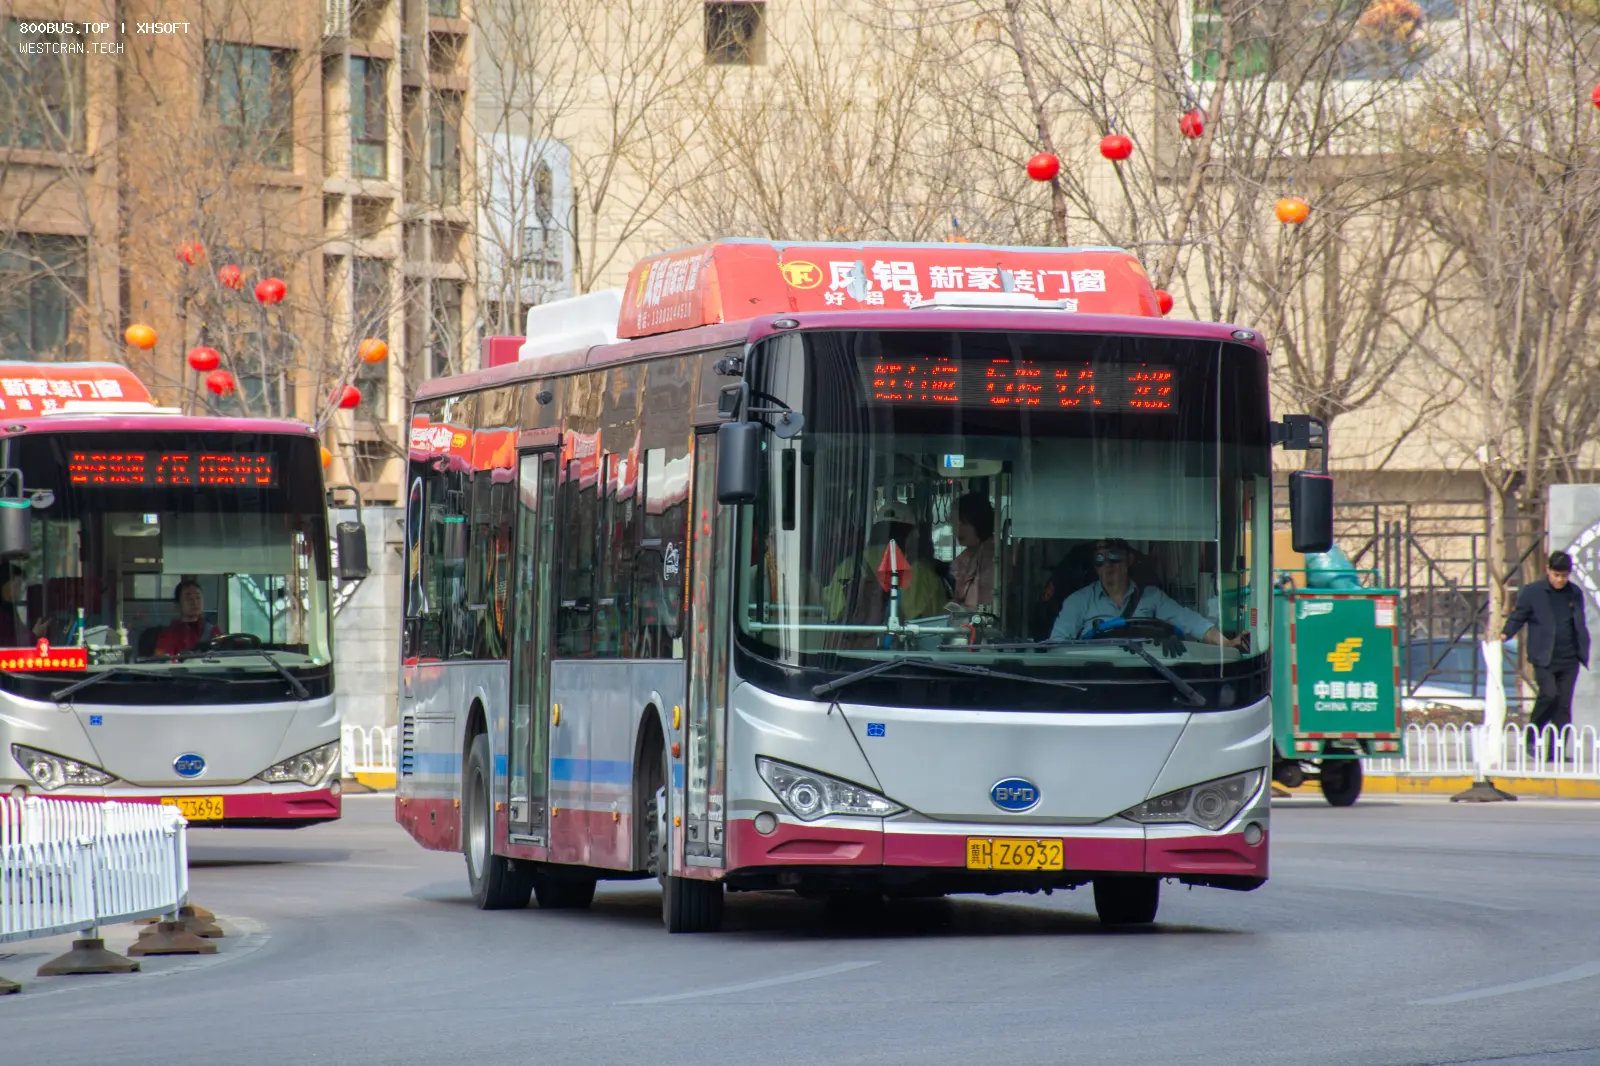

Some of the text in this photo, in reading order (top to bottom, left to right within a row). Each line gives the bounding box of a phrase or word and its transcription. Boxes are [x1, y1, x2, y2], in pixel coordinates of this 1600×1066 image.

[1315, 701, 1378, 711] CHINA POST
[996, 787, 1034, 802] BYD
[163, 800, 222, 817] Z3696
